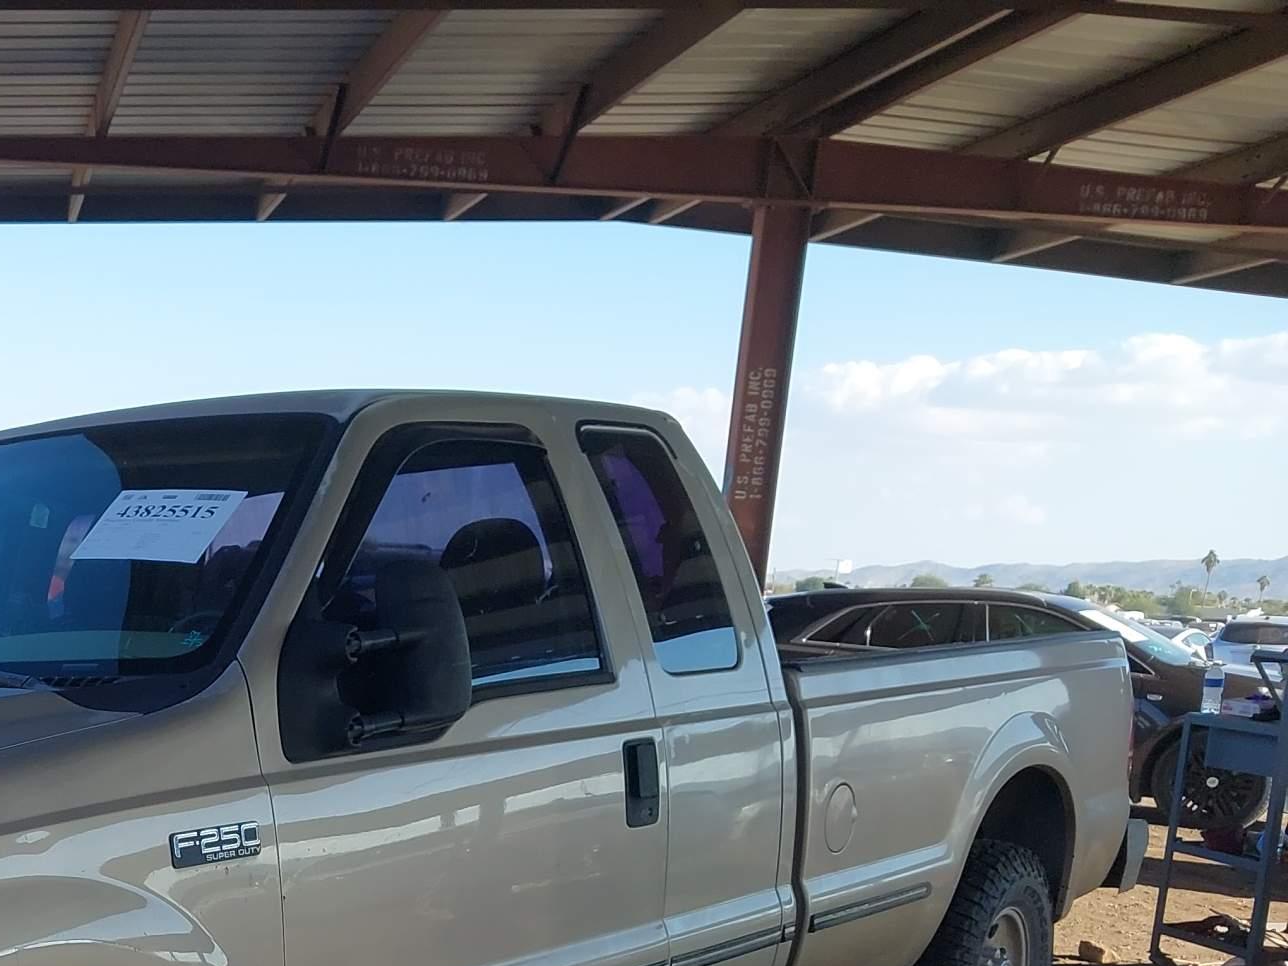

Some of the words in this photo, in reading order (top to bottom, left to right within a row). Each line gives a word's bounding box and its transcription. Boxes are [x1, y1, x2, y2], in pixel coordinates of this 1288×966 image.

[739, 403, 759, 463] PREFAB
[116, 504, 220, 519] 43825515
[173, 822, 261, 858] F-250
[206, 850, 236, 862] SUPER
[238, 846, 261, 856] DUTY
